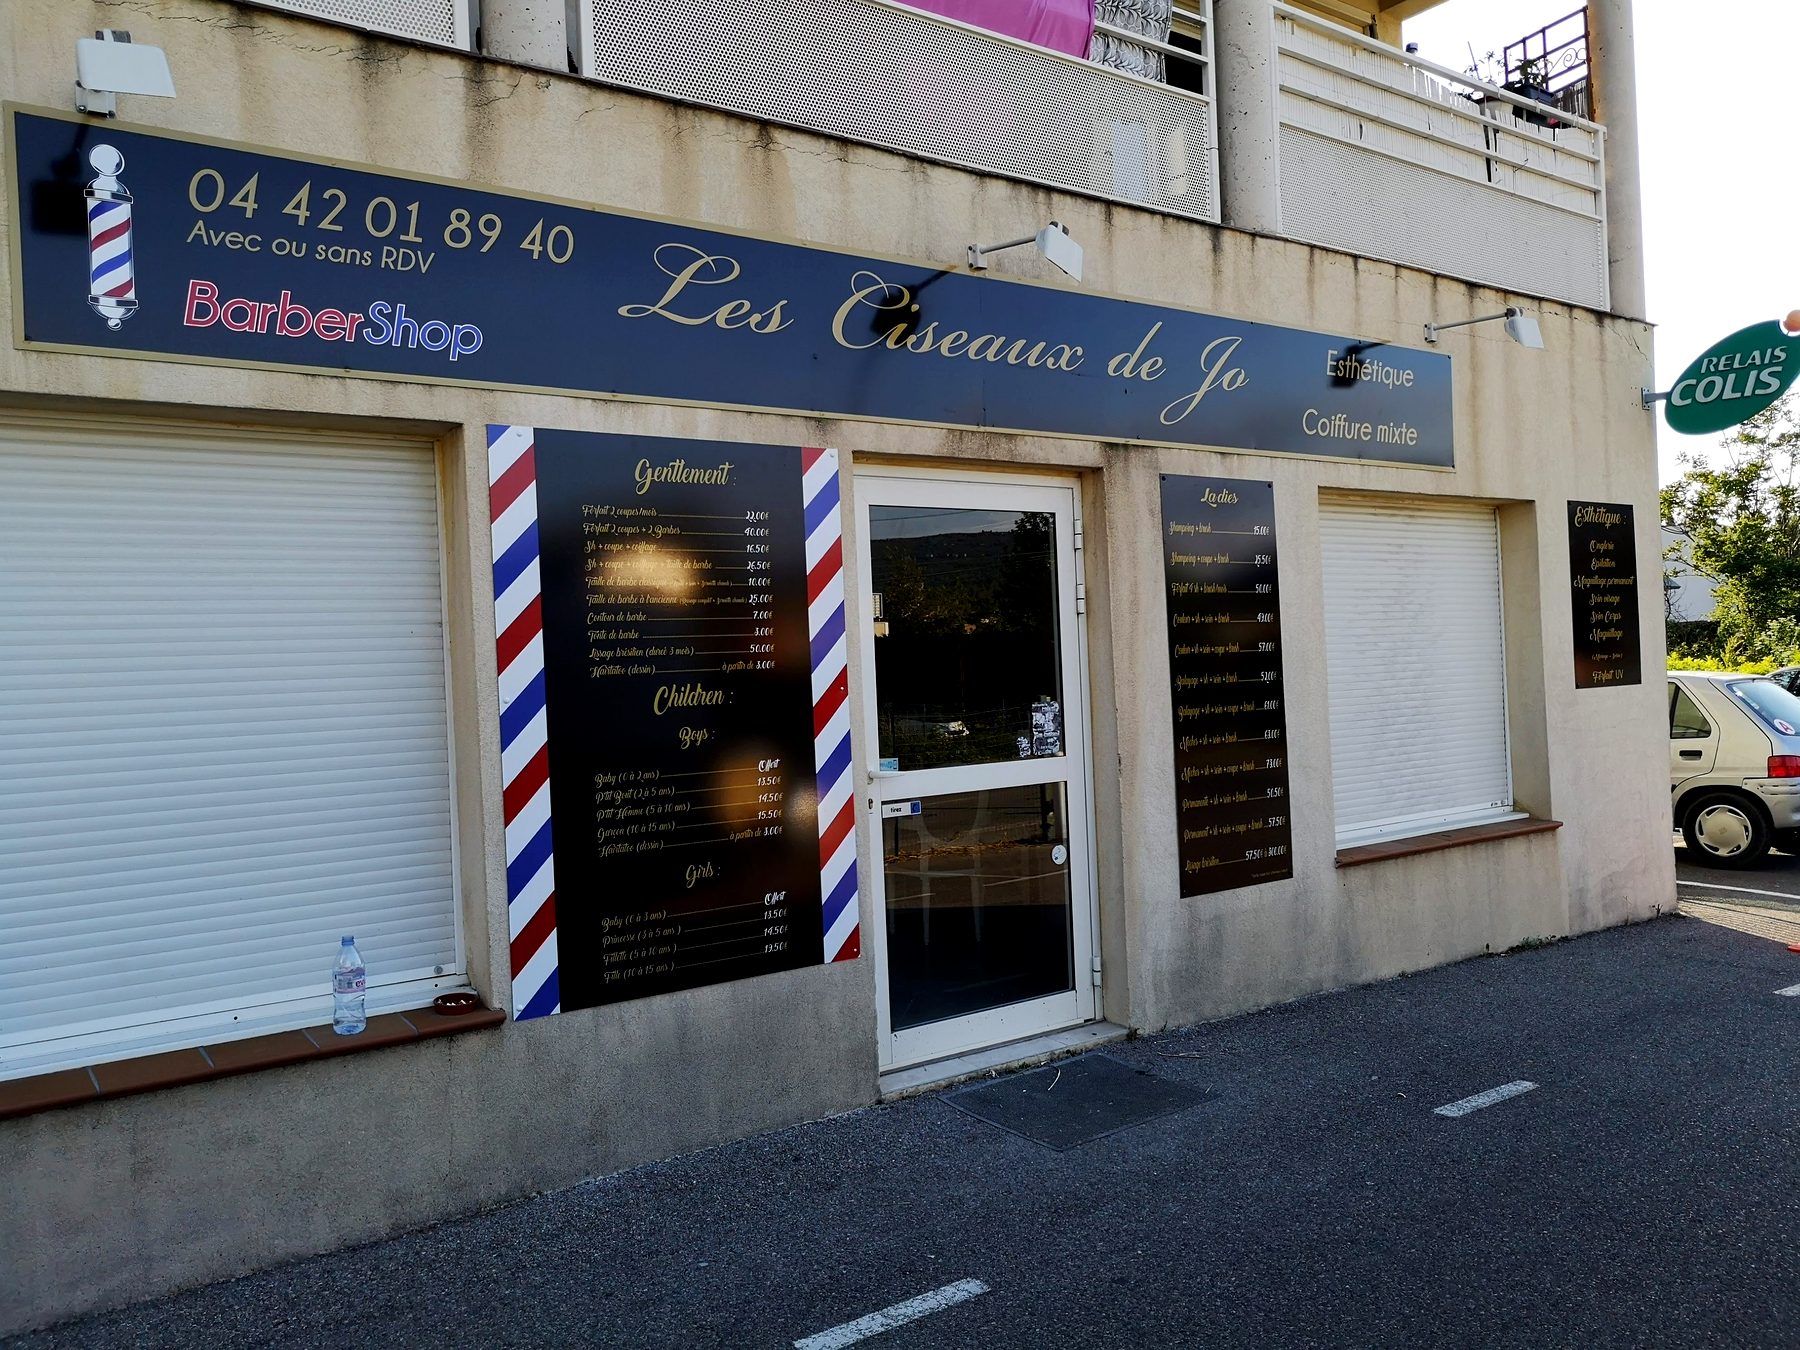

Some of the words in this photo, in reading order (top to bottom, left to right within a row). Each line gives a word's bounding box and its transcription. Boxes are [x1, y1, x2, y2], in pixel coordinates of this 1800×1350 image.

[188, 168, 259, 219] 04
[282, 180, 344, 231] 42
[365, 196, 424, 243] 01
[443, 208, 502, 253] 89
[519, 218, 575, 264] 40
[186, 219, 262, 253] Avec
[272, 235, 307, 259] ou
[316, 241, 373, 267] sans
[380, 246, 436, 274] RDV
[182, 278, 484, 362] BarberShop
[617, 242, 795, 334] Les
[832, 270, 1085, 372] Ciseaux
[1107, 321, 1167, 381] de
[1159, 336, 1250, 425] Jo
[1326, 350, 1414, 389] Esthétique
[1700, 345, 1788, 374] RELAIS
[1671, 366, 1783, 407] COLIS
[1302, 408, 1372, 441] Coiffure
[1376, 422, 1418, 446] mixte
[1200, 487, 1239, 508] Ladies
[582, 504, 610, 519] Forfait
[611, 506, 618, 519] 2
[746, 511, 770, 523] 22.00€
[583, 522, 610, 536] Forfait
[611, 524, 618, 536] 2
[744, 527, 770, 537] 40.00€
[746, 544, 770, 553] 16.50€
[747, 561, 772, 573] 26.50€
[748, 577, 772, 587] 10.00€
[749, 594, 774, 606] 25.00€
[753, 610, 774, 620] 7.00€
[750, 643, 776, 653] 50.00€
[653, 683, 725, 716] Children
[1779, 720, 1793, 733] A
[679, 726, 709, 750] Boys
[594, 772, 617, 789] Baby
[685, 861, 714, 889] Girls
